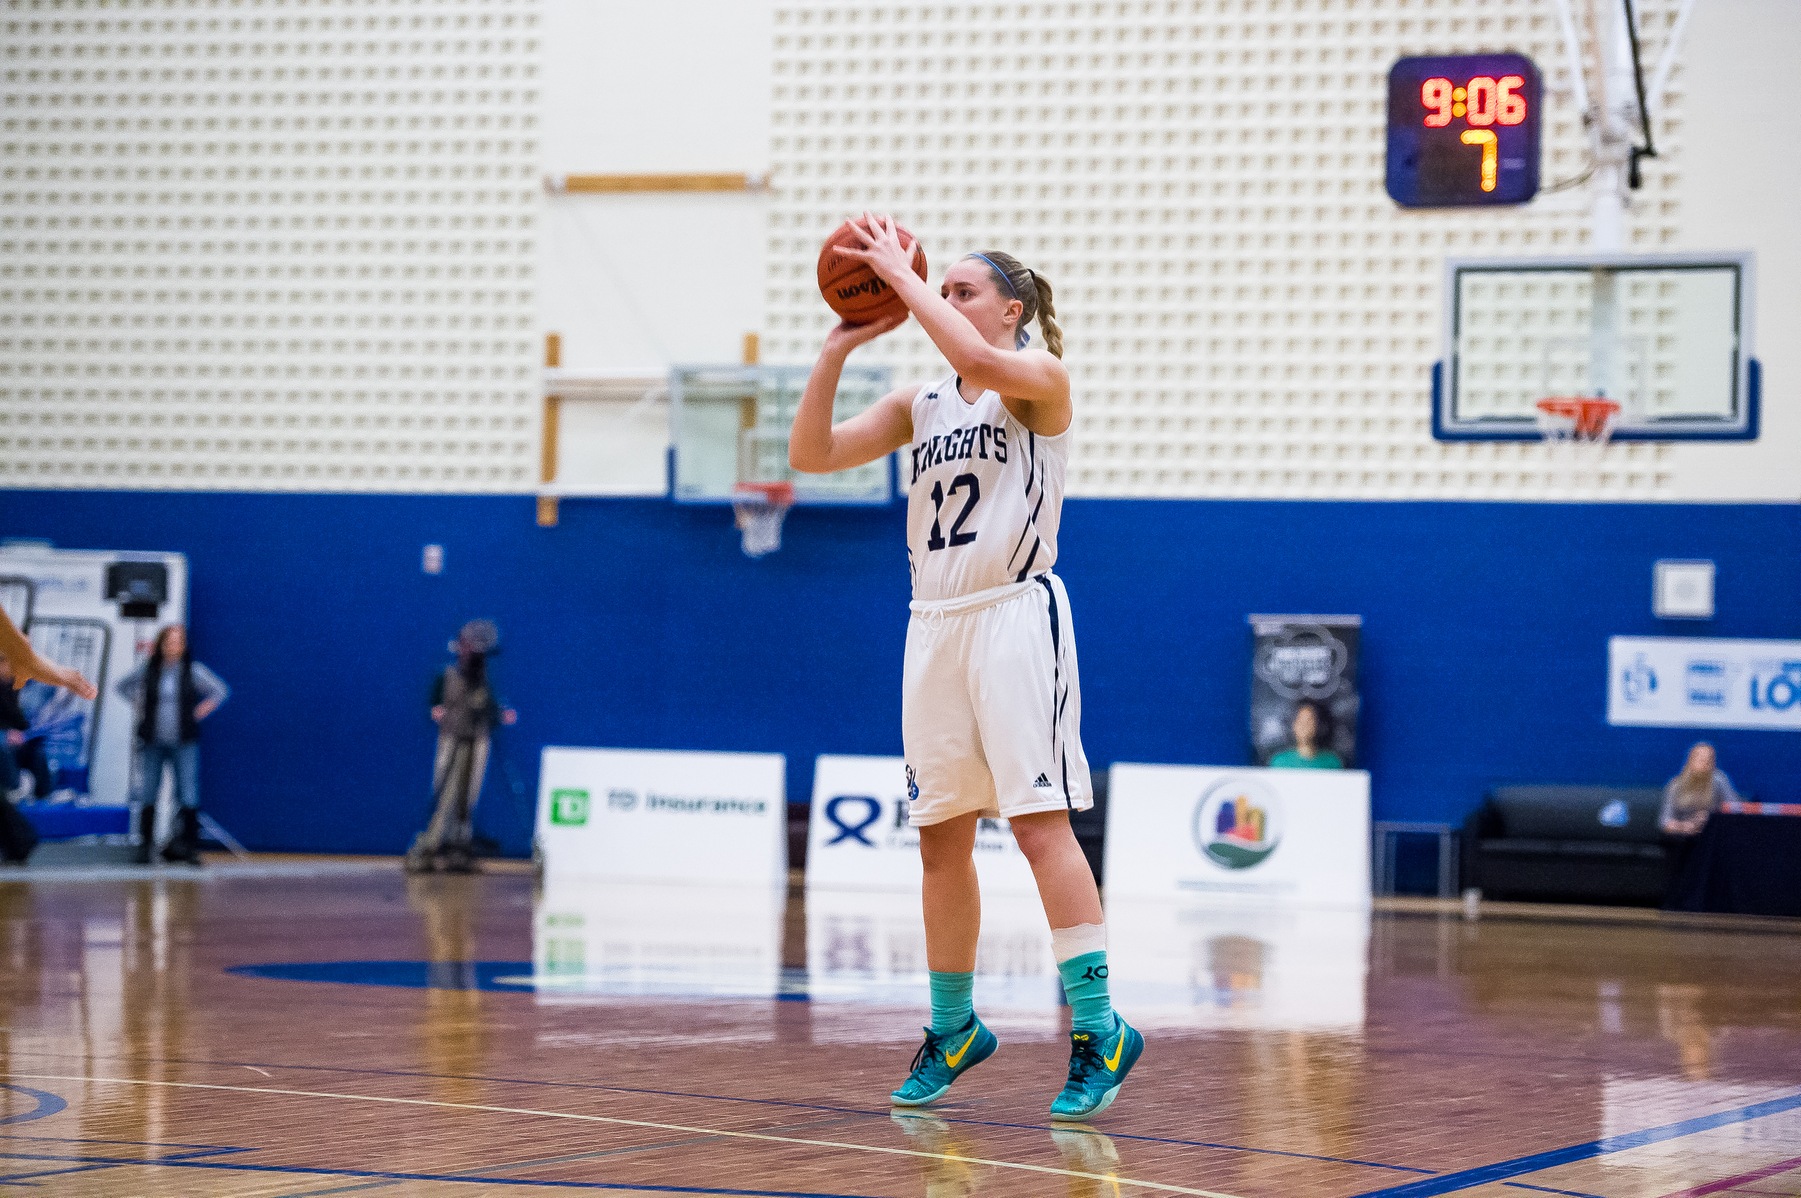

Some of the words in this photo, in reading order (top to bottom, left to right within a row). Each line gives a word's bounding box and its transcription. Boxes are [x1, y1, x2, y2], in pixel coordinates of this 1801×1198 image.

[1421, 75, 1527, 127] 9:06
[1460, 129, 1498, 193] 7
[911, 423, 1008, 485] KNIGHTS
[927, 472, 981, 552] 12
